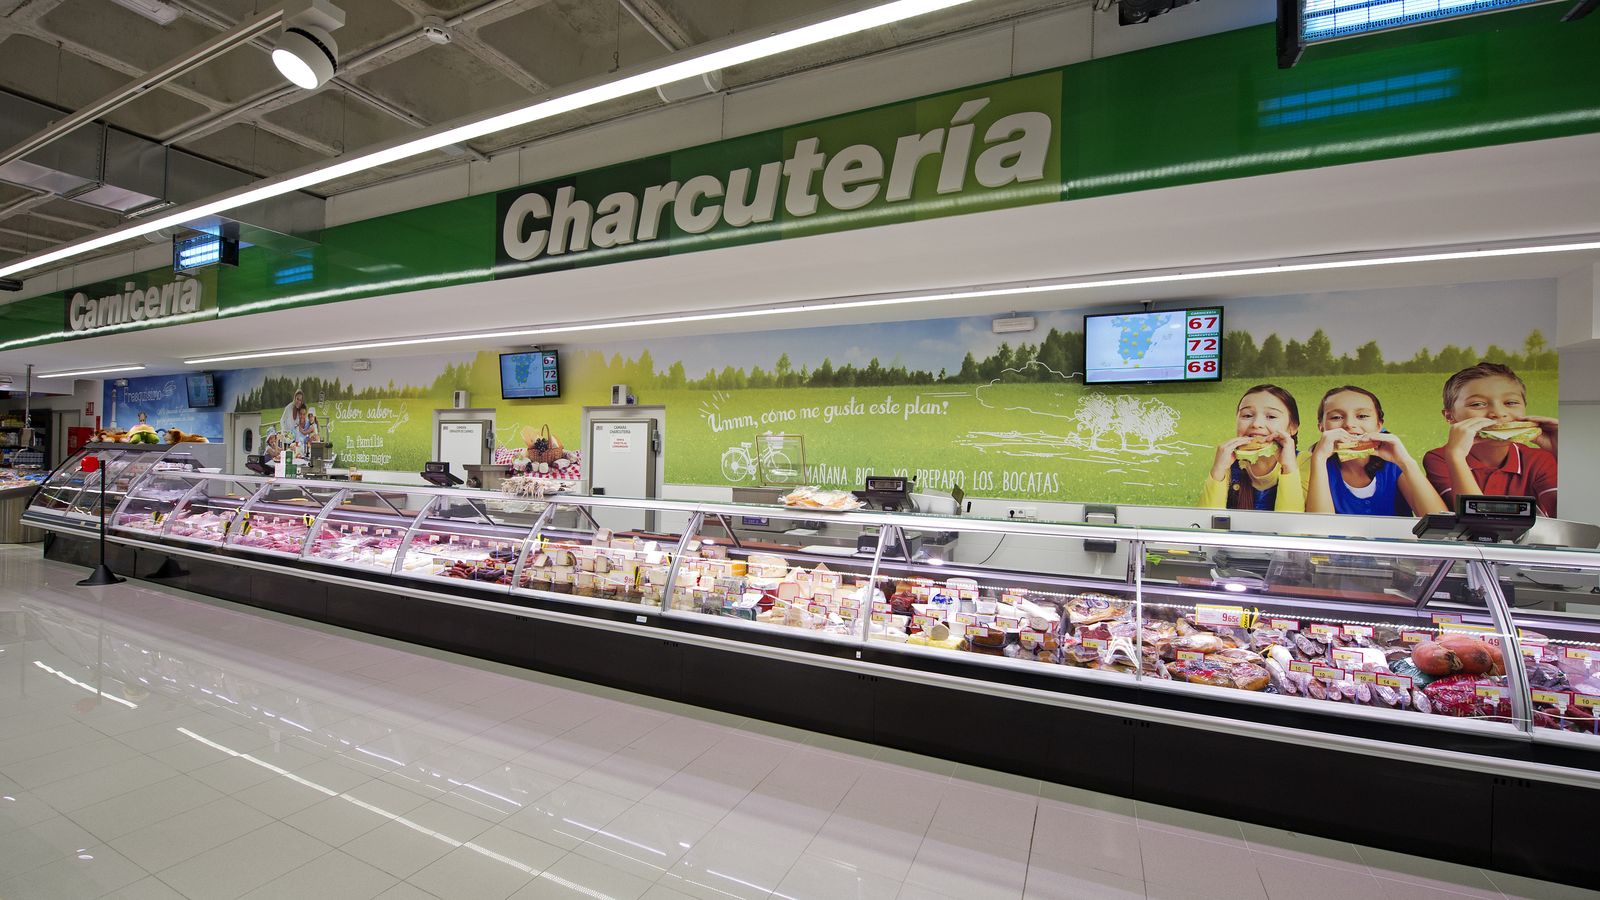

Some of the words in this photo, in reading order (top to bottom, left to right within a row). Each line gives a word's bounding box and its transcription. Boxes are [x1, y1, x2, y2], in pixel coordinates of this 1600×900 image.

[503, 97, 1053, 261] Charcutería
[1188, 317, 1218, 329] 67
[1188, 339, 1216, 351] 72
[544, 356, 556, 364] 67
[1188, 361, 1217, 372] 68
[544, 370, 556, 378] 72
[545, 384, 557, 392] 68
[336, 401, 362, 419] Sabor
[800, 406, 820, 419] me
[824, 396, 864, 424] gusta
[869, 395, 900, 414] este
[904, 395, 949, 421] plan!
[346, 436, 354, 448] En
[356, 435, 384, 448] familia
[341, 451, 355, 462] todo
[356, 450, 370, 462] sabe
[372, 452, 392, 466] mejor
[916, 468, 965, 490] PREPARO
[973, 471, 994, 491] LOS
[1003, 471, 1060, 494] BOCATAS
